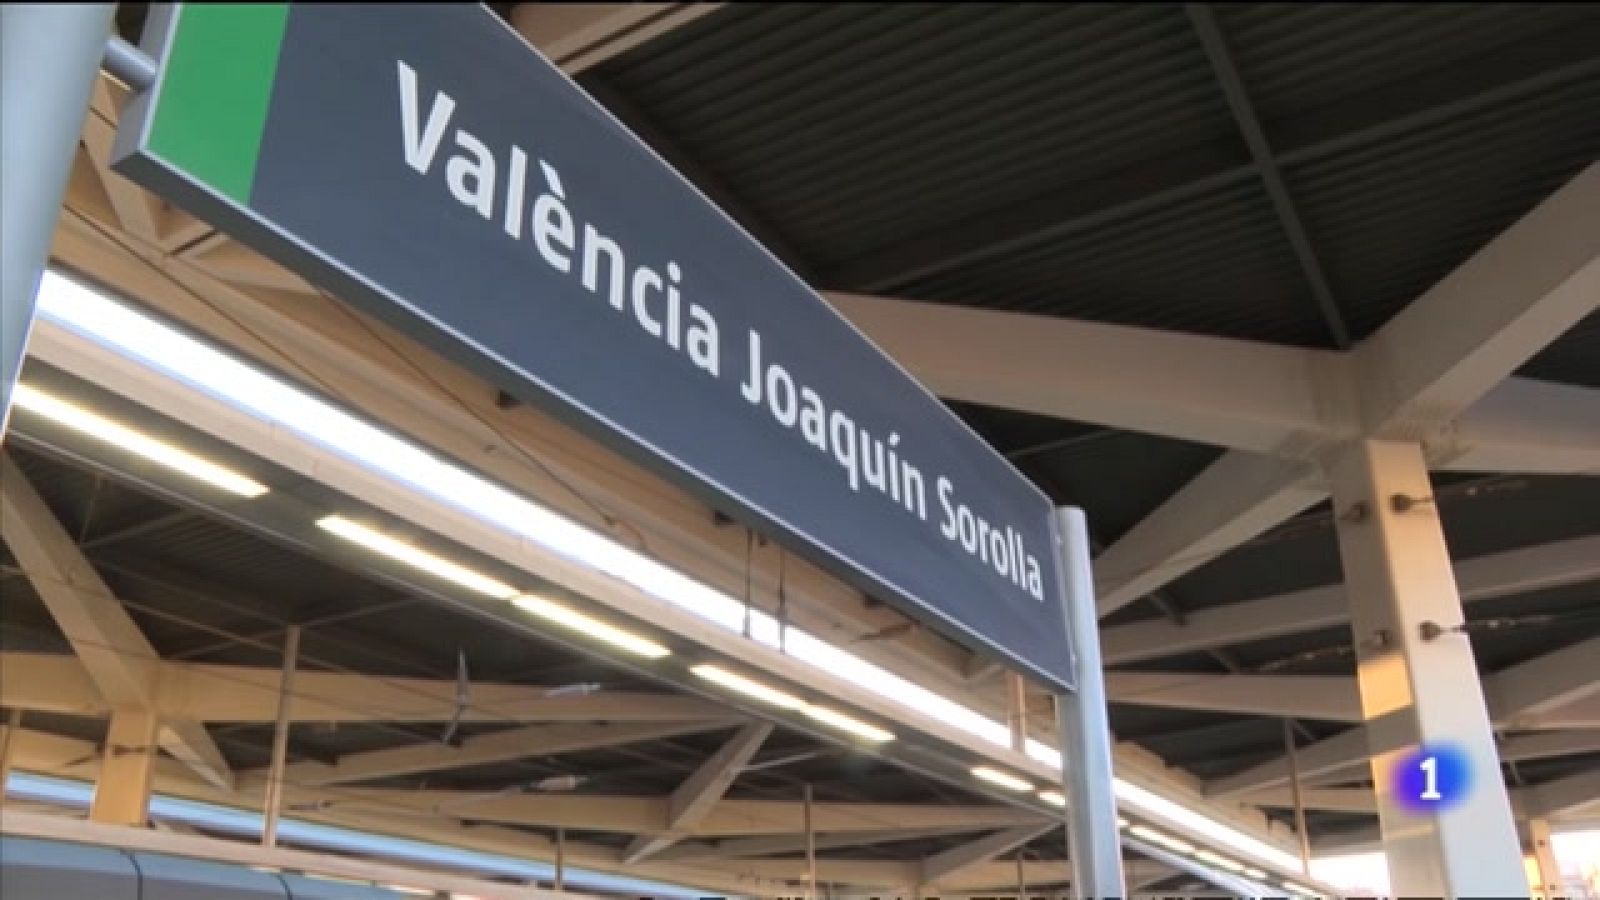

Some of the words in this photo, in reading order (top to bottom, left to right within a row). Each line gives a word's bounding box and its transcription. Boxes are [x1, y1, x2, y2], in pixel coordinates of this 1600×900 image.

[397, 59, 720, 378] València
[740, 329, 928, 521] Joaquín
[936, 476, 1044, 602] Sorolla
